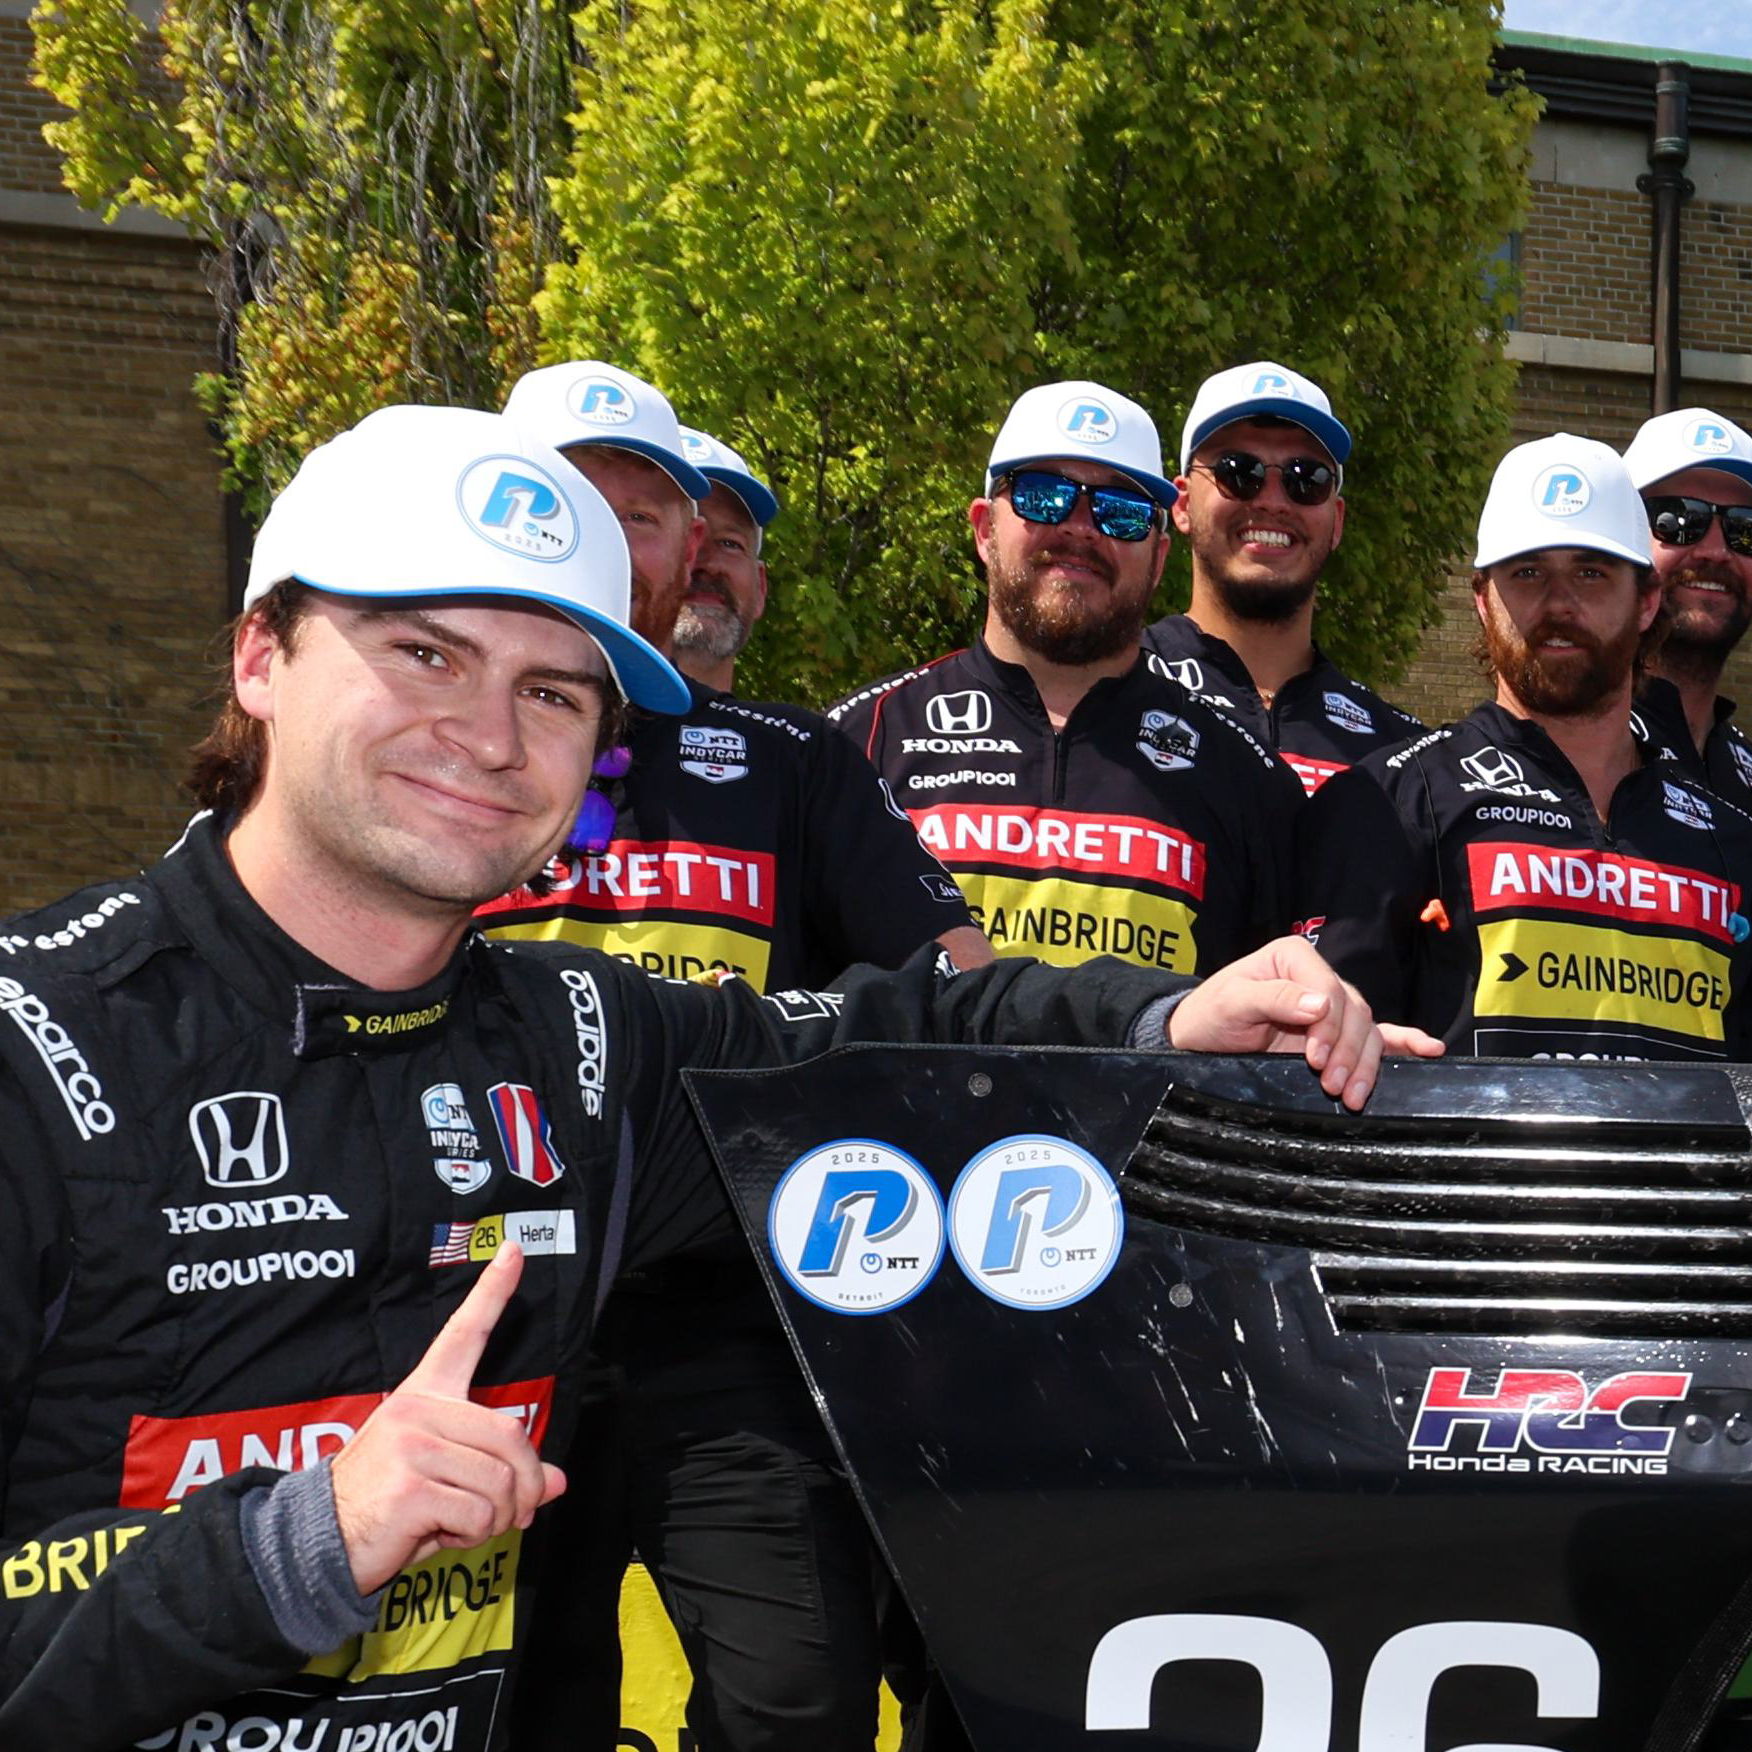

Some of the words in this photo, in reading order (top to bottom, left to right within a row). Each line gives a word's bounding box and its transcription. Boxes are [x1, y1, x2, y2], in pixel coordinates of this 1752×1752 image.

[828, 668, 930, 722] Firestone
[679, 745, 746, 760] INDYCAR
[709, 735, 739, 746] NTT
[902, 739, 1023, 754] HONDA
[909, 770, 1017, 790] GROUP1001
[1476, 806, 1572, 830] GROUP1001
[918, 813, 1193, 882] ANDRETTI
[1490, 853, 1729, 928] ANDRETTI
[968, 904, 1180, 969] GAINBRIDGE
[1537, 952, 1723, 1011] GAINBRIDGE
[560, 968, 606, 1120] sparco
[831, 1152, 881, 1166] 2025
[1003, 1148, 1053, 1164] 2025
[162, 1193, 349, 1235] HONDA
[475, 1225, 498, 1249] 26
[519, 1224, 556, 1243] Herta
[886, 1256, 919, 1270] NTT
[1065, 1247, 1097, 1262] NTT
[167, 1249, 355, 1296] GROUP1001
[837, 1291, 885, 1303] DETROIT
[1407, 1366, 1693, 1455] HRC
[1407, 1454, 1530, 1472] Honda
[1538, 1455, 1668, 1476] RACING
